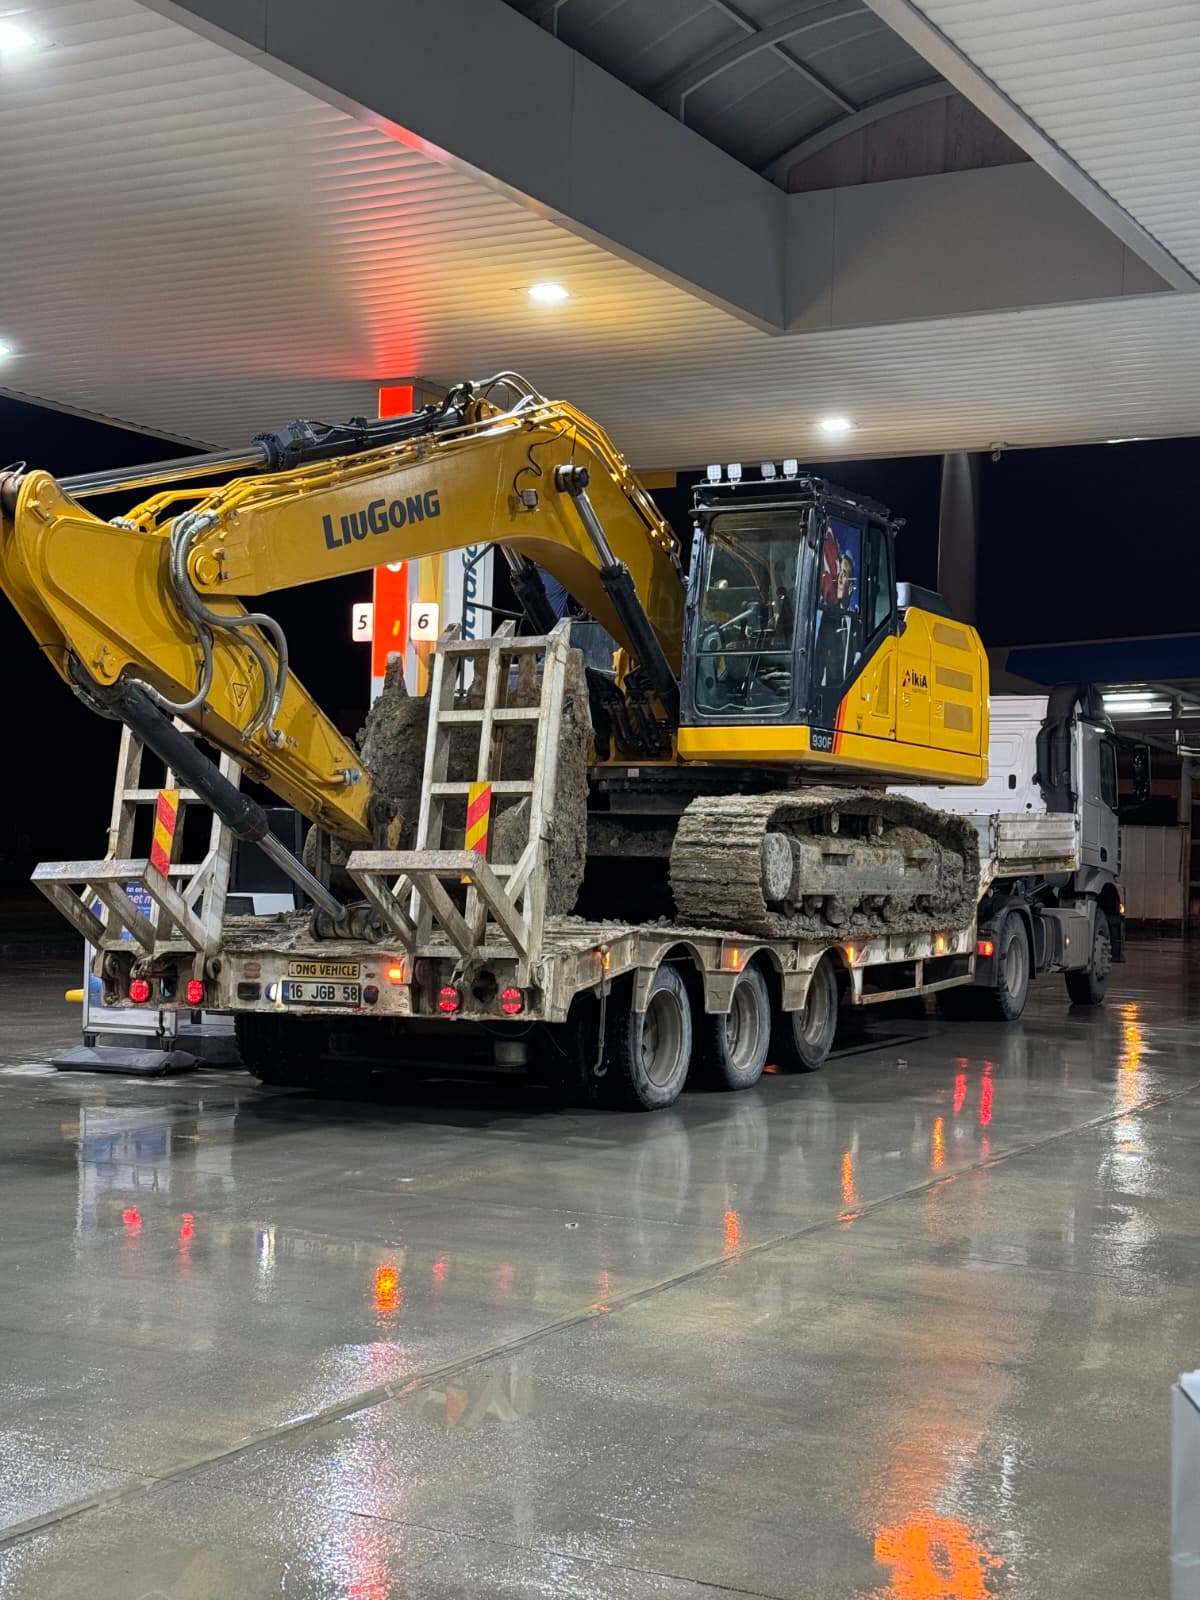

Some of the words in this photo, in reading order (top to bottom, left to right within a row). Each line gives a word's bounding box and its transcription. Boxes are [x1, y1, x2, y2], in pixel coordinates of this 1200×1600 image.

[357, 615, 368, 630] 5
[417, 614, 429, 629] 6
[812, 734, 832, 749] 930F
[291, 964, 317, 975] LONG
[319, 965, 358, 977] VEHICLE
[291, 984, 303, 999] 16
[311, 985, 336, 1000] JGB
[342, 987, 358, 1001] 58
